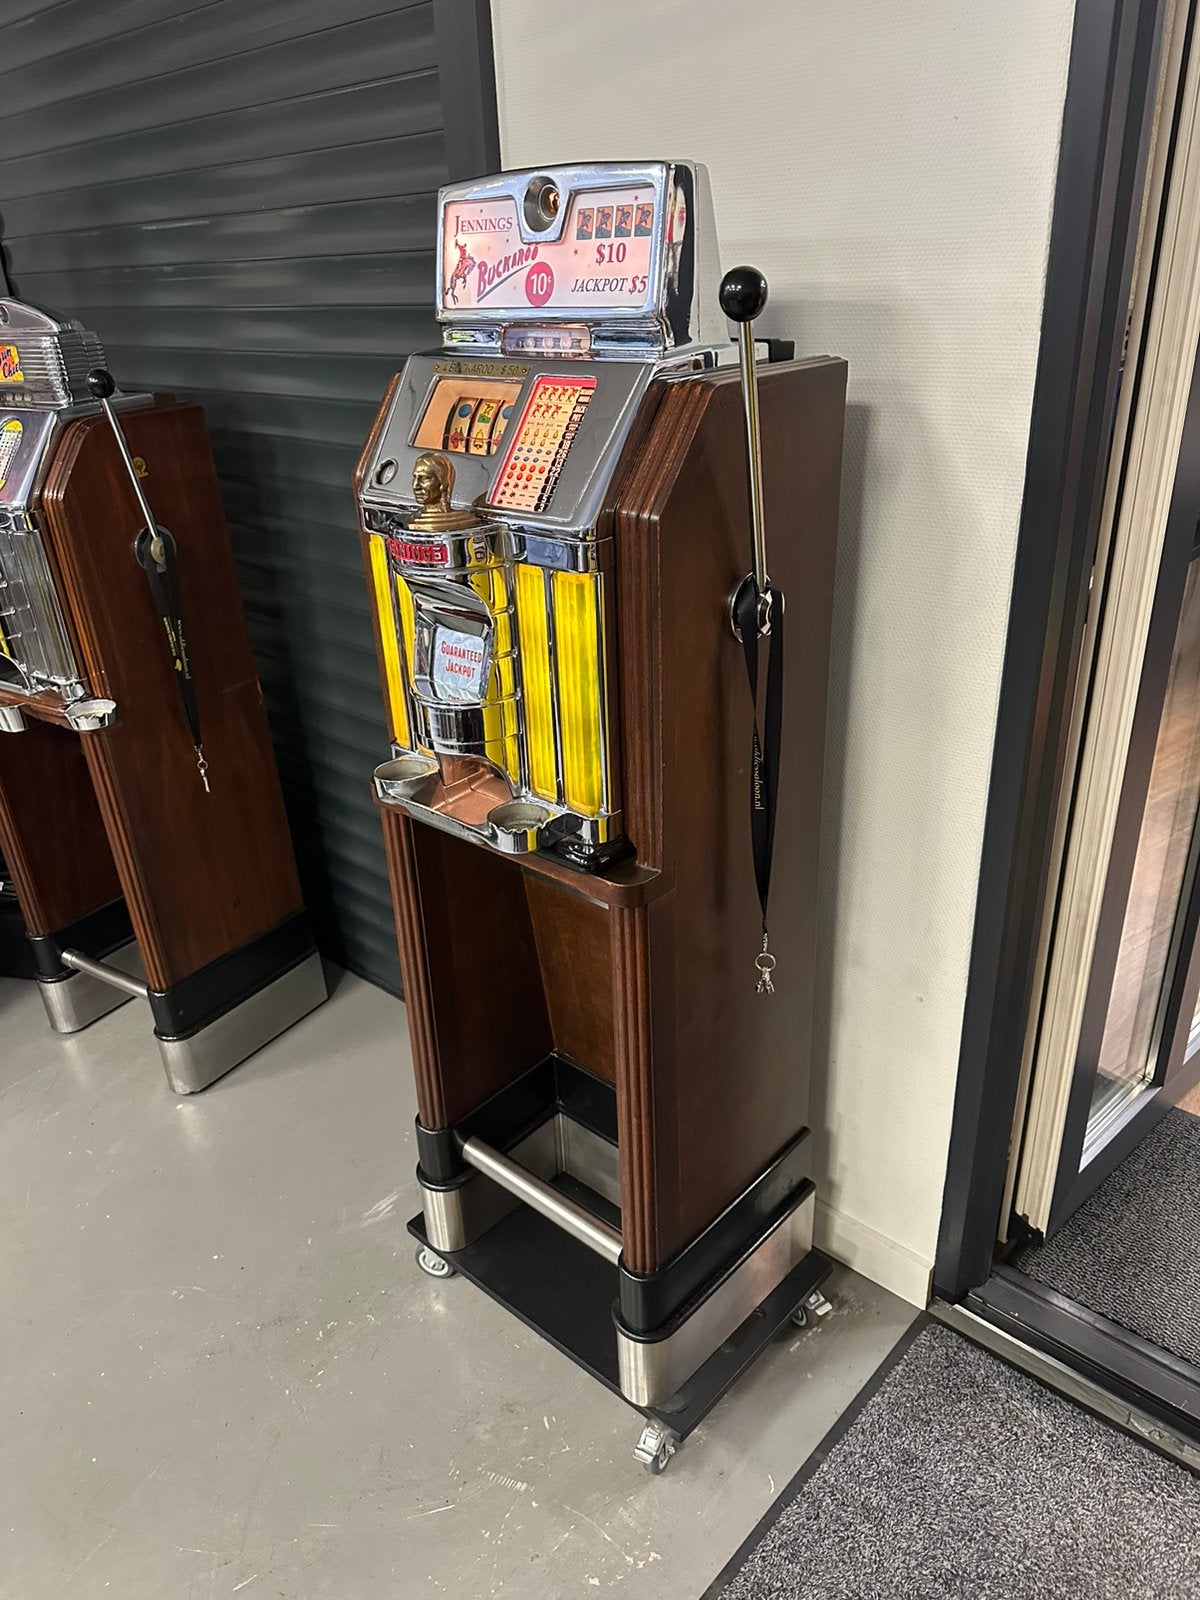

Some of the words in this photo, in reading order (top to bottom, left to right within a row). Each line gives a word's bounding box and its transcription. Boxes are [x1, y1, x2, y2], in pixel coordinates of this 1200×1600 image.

[454, 215, 513, 237] JENNINGS
[595, 242, 627, 265] $10
[477, 245, 539, 298] BUCKAROO
[571, 277, 628, 293] JACKPOT
[440, 640, 483, 664] GUARANTEED
[445, 658, 476, 678] JACKPOT
